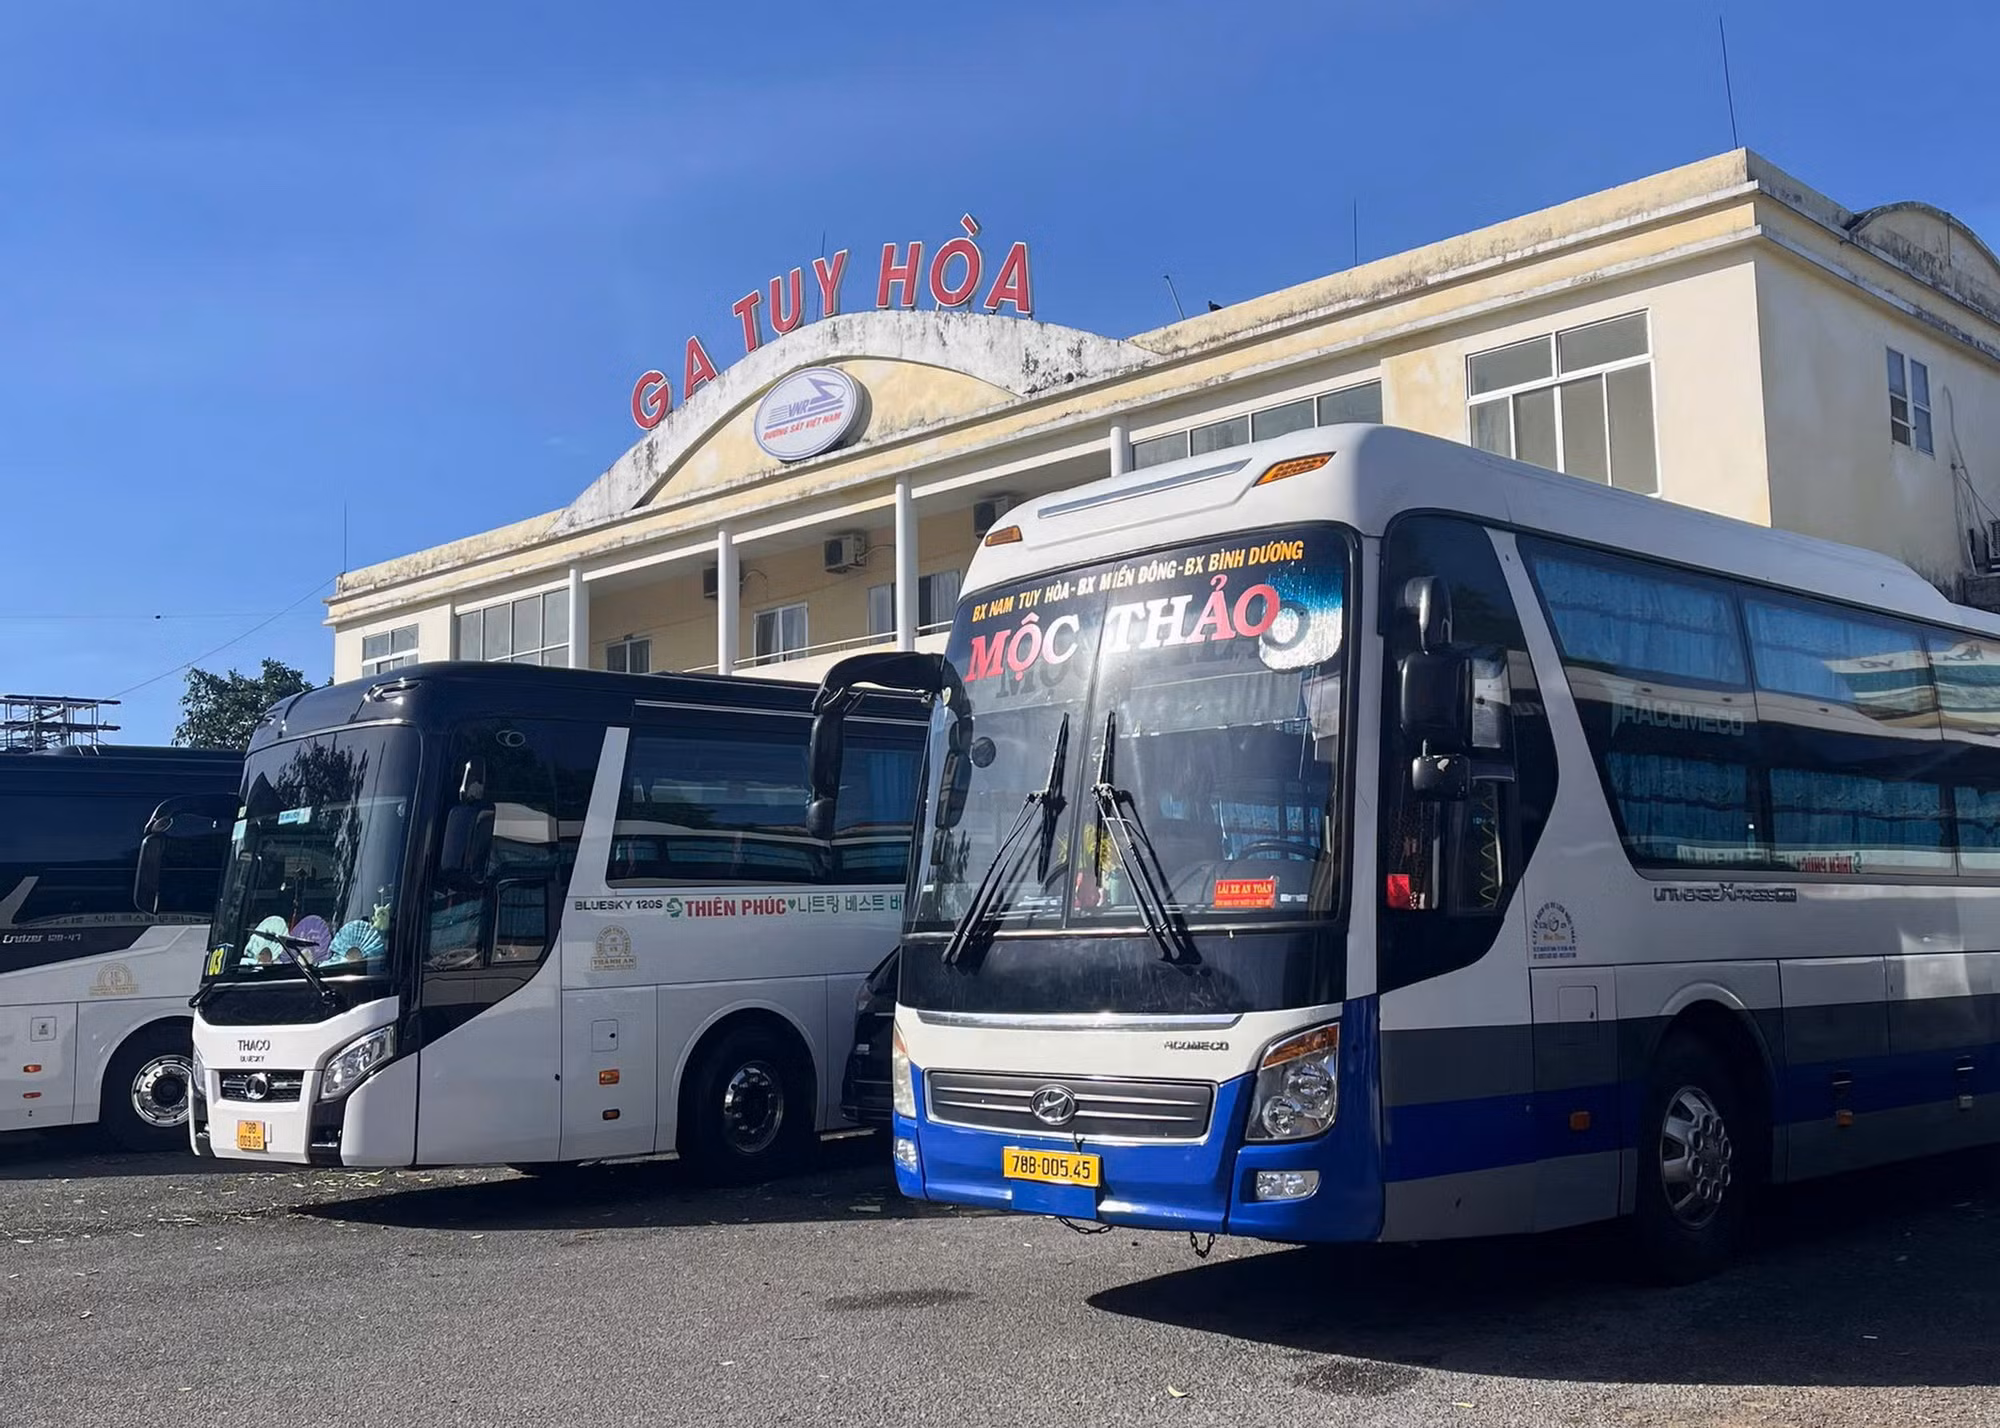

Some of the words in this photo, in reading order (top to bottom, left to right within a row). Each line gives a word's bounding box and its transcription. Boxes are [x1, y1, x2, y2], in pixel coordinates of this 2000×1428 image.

[631, 336, 718, 431] GA
[732, 249, 849, 354] TUY
[875, 213, 1032, 314] HÒA
[788, 399, 811, 418] VNR
[972, 602, 988, 622] BX
[988, 596, 1015, 618] NAM
[1018, 588, 1042, 610] TUY
[1208, 547, 1246, 572] BÌNH
[1248, 540, 1305, 566] DƯƠNG
[964, 611, 1080, 681] MỘC
[1098, 574, 1281, 655] THẢO
[574, 900, 633, 911] BLUESKY
[636, 899, 663, 909] 120S
[685, 896, 736, 918] THIÊN
[741, 895, 787, 916] PHÚC
[798, 895, 840, 914] 나트랑
[845, 895, 885, 912] 베스트
[208, 946, 225, 976] 03
[239, 1040, 271, 1051] THACO
